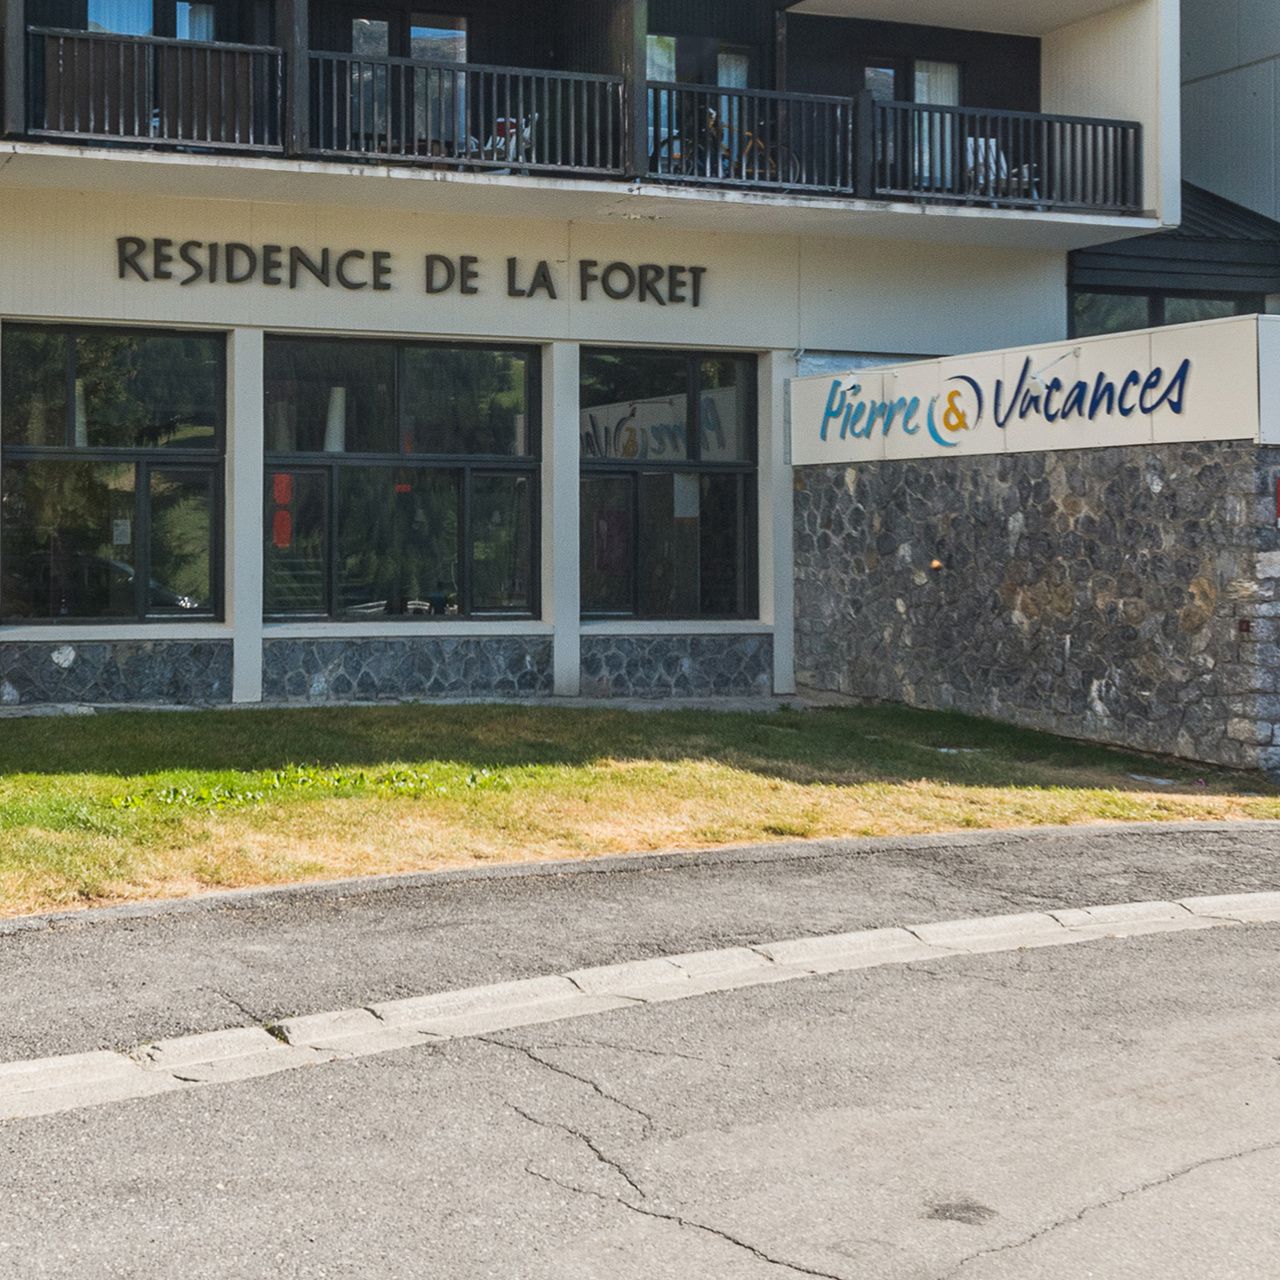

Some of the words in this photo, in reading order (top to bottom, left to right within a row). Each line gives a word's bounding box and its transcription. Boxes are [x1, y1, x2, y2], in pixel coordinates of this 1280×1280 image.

[117, 236, 392, 291] RESIDENCE
[426, 254, 480, 296] DE
[507, 256, 557, 300] LA
[580, 258, 707, 308] FORET
[820, 380, 921, 442] Pierre
